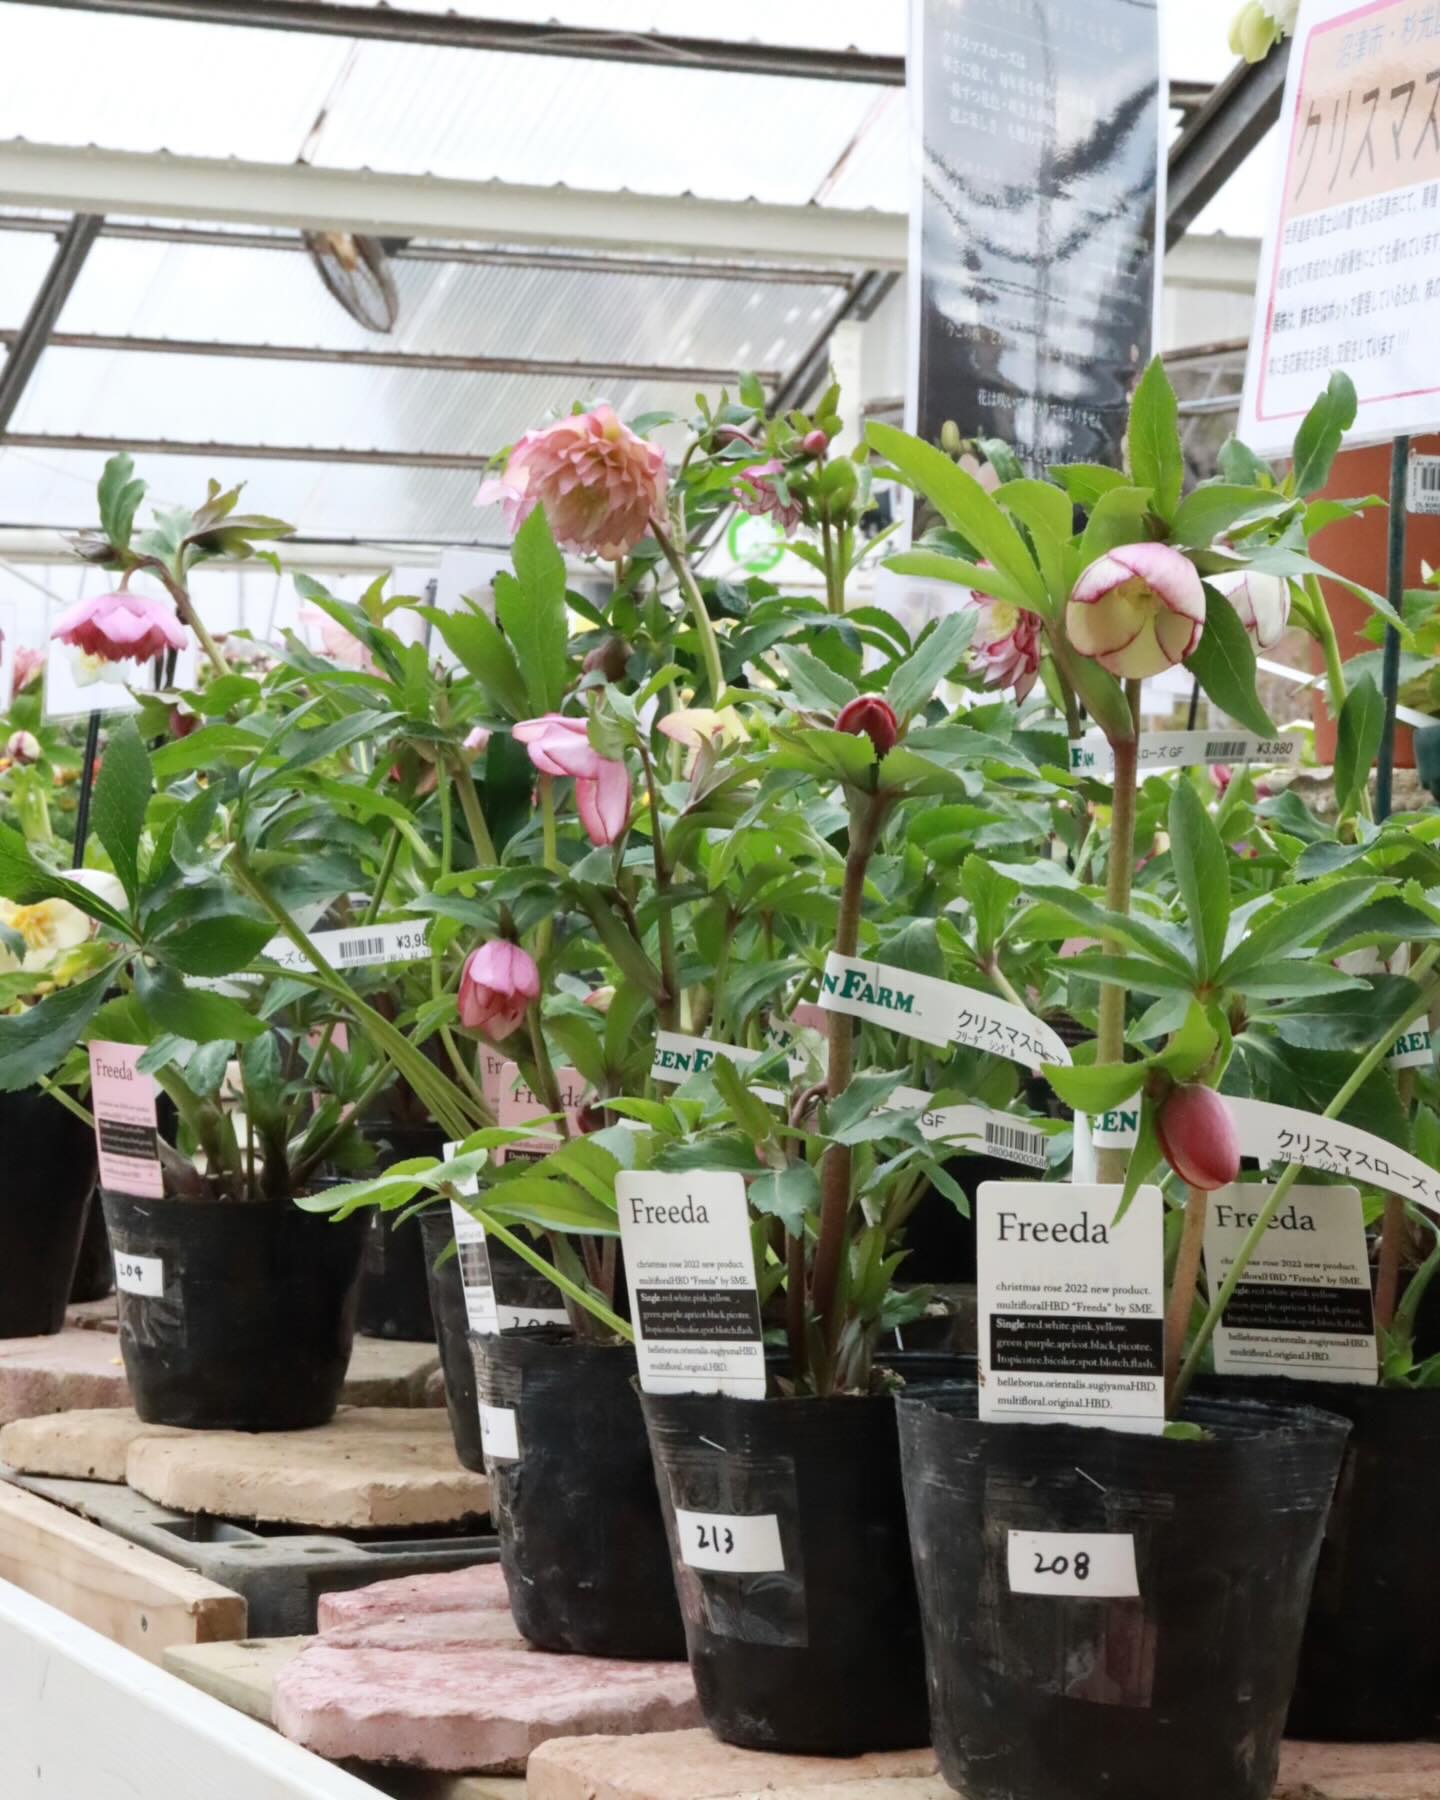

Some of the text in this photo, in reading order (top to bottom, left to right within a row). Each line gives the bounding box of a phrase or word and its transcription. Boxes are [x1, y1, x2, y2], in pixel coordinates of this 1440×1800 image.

[95, 1058, 134, 1081] Freeda
[629, 1194, 710, 1224] Freeda
[997, 1211, 1110, 1244] Freeda
[996, 1281, 1152, 1297] christmas rose 2022 new product.
[1114, 1302, 1126, 1316] by
[1128, 1302, 1156, 1314] SME.
[696, 1524, 734, 1554] 213
[1034, 1551, 1091, 1581] 208
